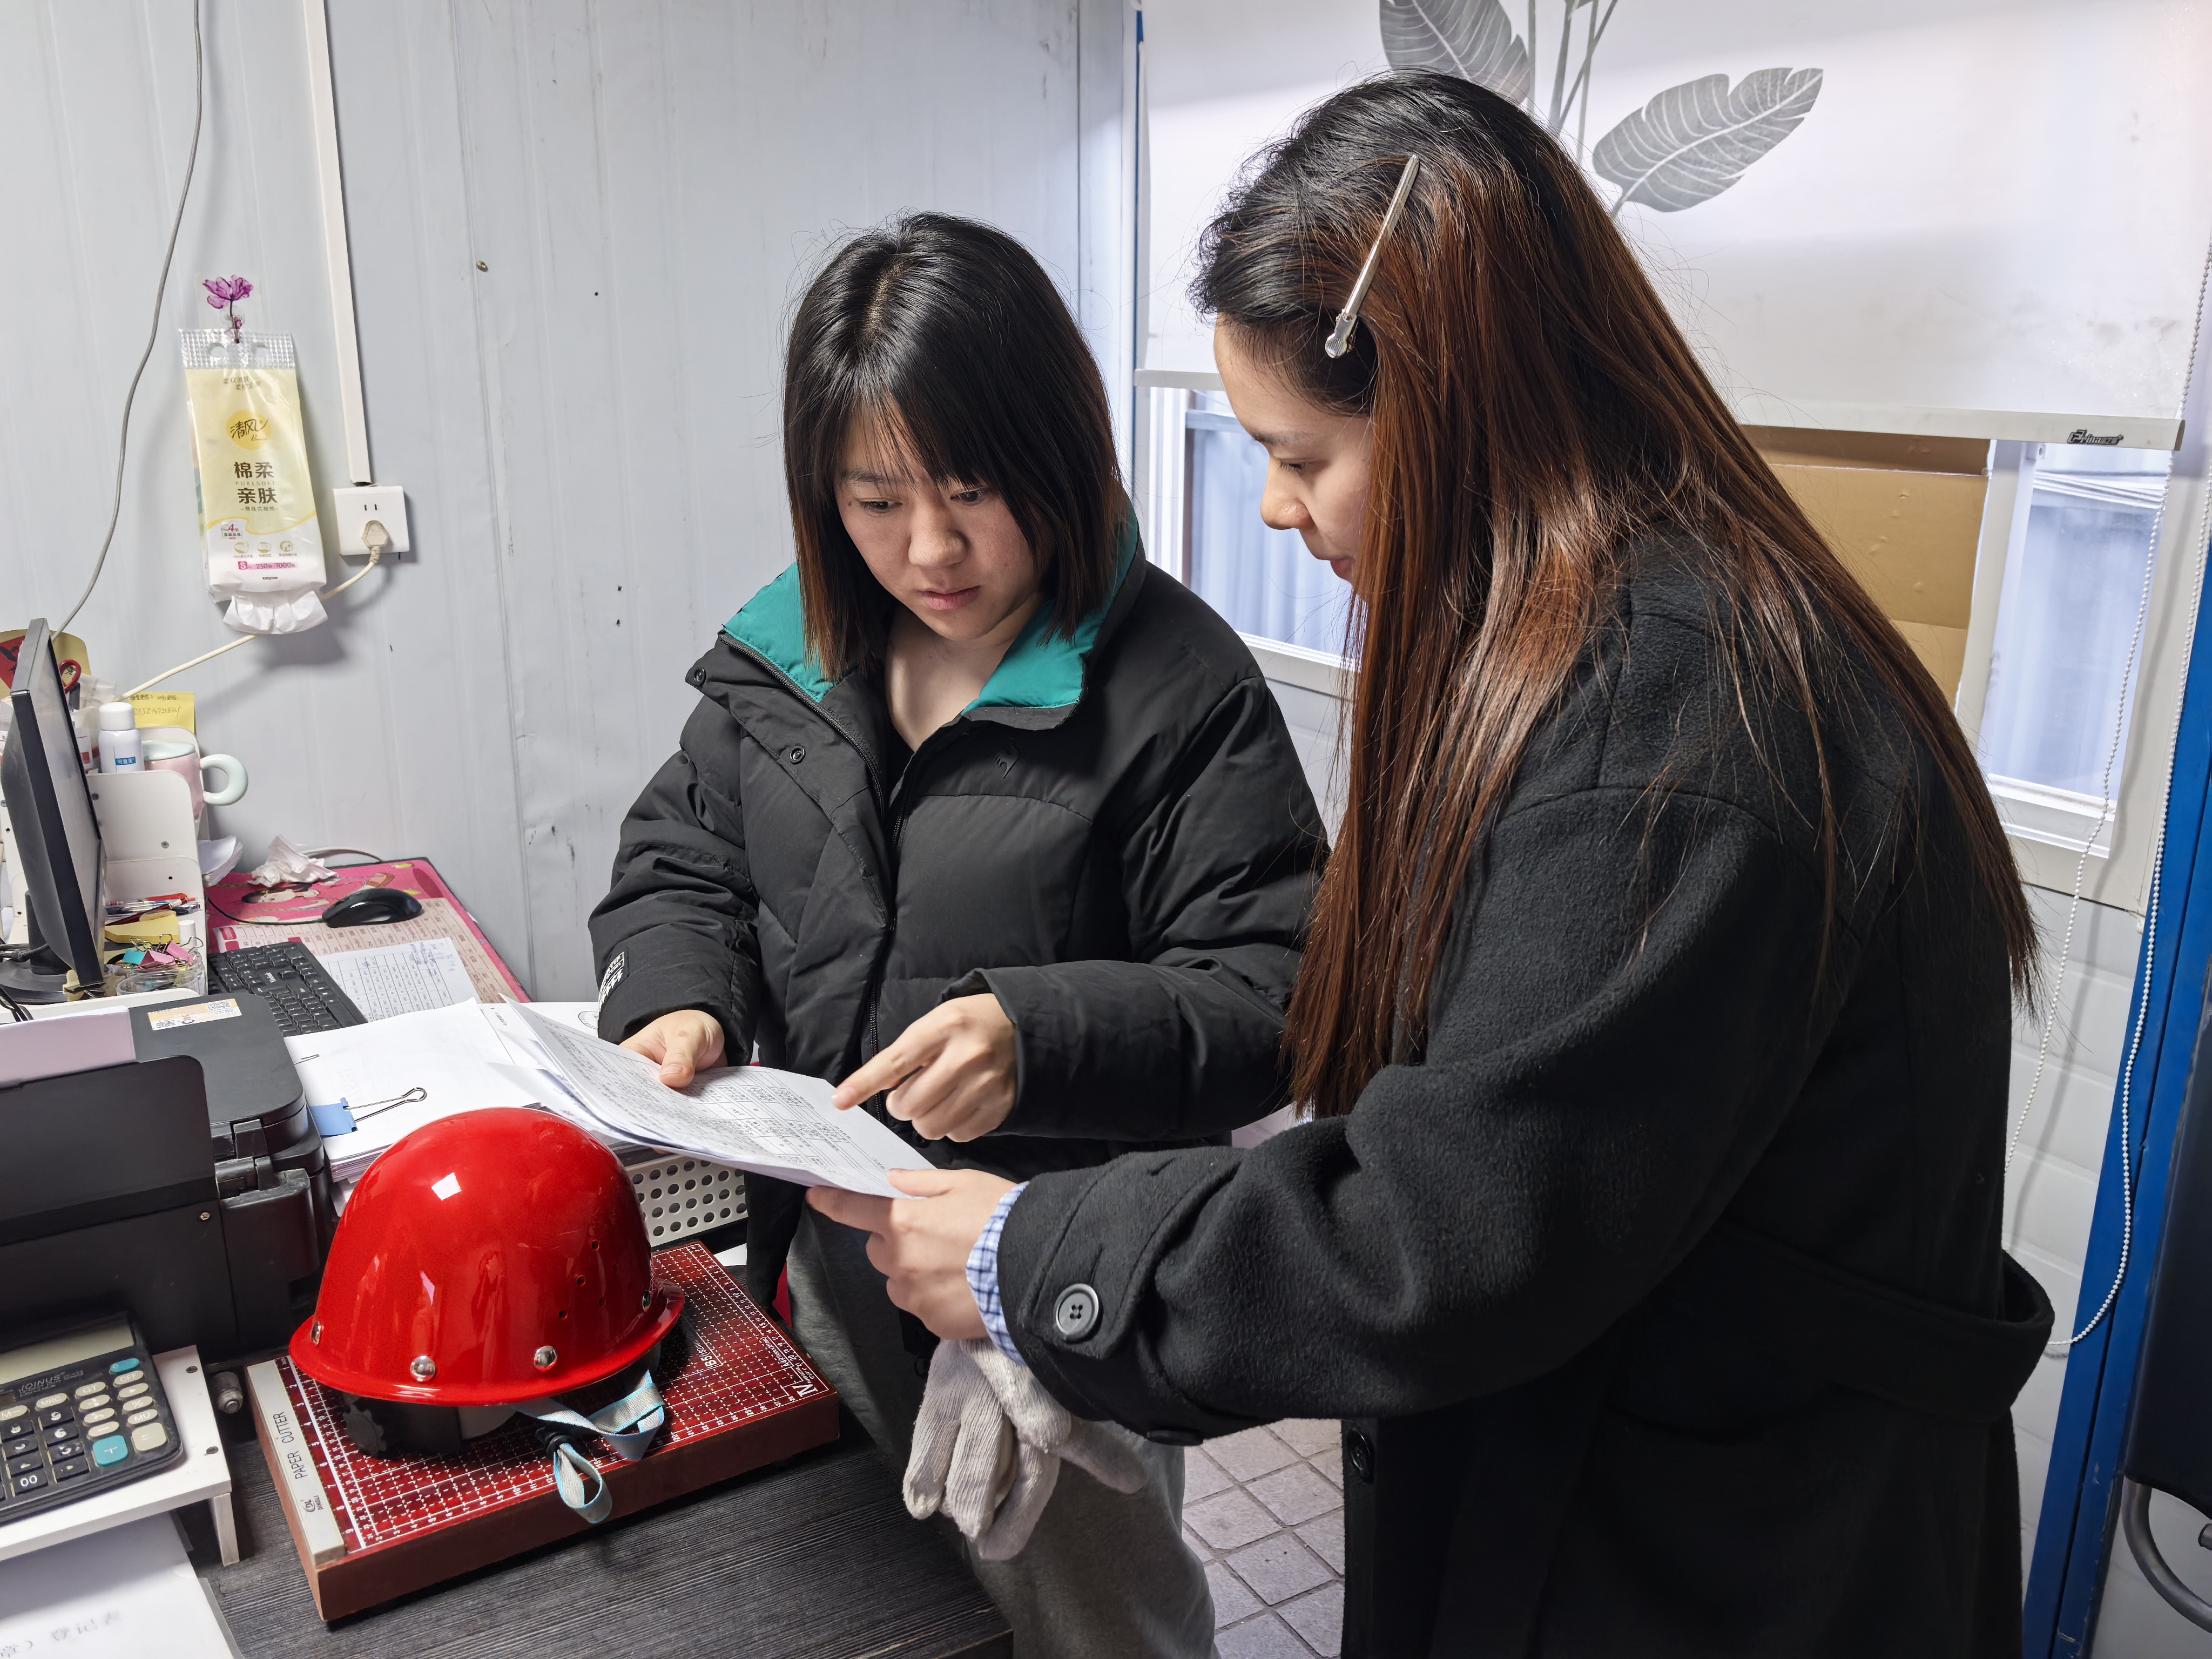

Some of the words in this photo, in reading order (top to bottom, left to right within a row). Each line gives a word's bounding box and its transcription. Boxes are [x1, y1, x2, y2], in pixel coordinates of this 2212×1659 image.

[230, 418, 268, 439] 清风
[234, 462, 274, 479] 棉柔
[238, 487, 278, 504] 亲肤
[120, 1373, 137, 1382] OFF
[82, 1385, 97, 1393] GT
[41, 1396, 61, 1406] MRC
[134, 1412, 151, 1422] MU
[55, 1427, 66, 1438] 6
[272, 1411, 294, 1443] CUTTER
[288, 1450, 308, 1479] PAPER
[20, 1474, 37, 1487] 00
[313, 1495, 323, 1510] DINGLI
